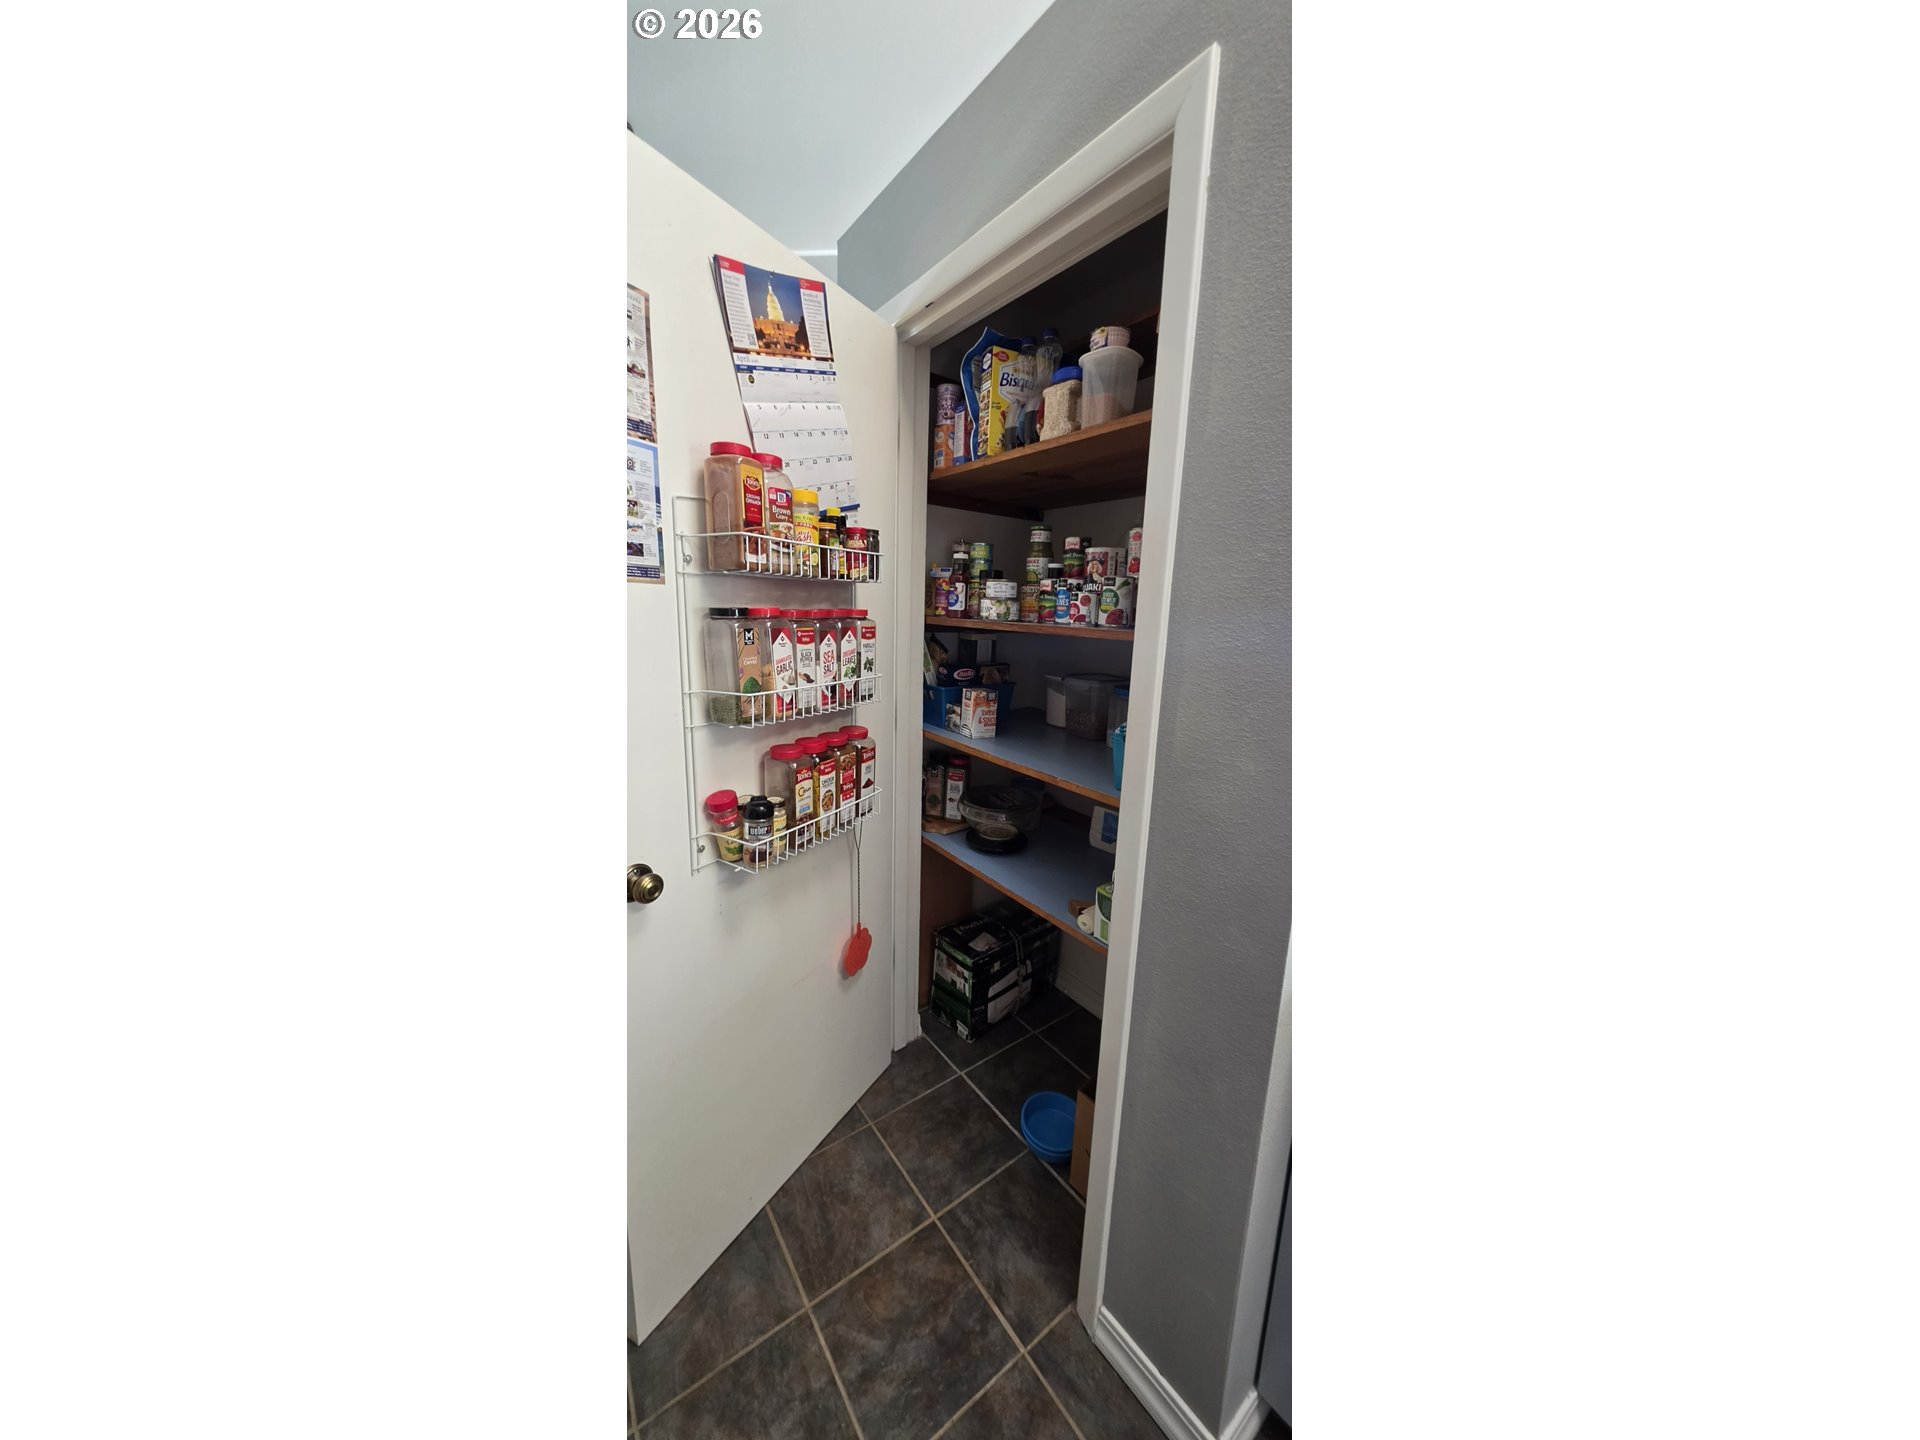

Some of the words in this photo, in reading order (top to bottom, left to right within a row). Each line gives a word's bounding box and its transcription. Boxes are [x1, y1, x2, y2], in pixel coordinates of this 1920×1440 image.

[772, 505, 791, 515] Brown
[823, 650, 835, 665] SEA
[842, 655, 856, 667] LEAVES
[776, 661, 793, 675] GARLIC
[823, 662, 835, 674] SALT
[863, 751, 875, 760] Tone's
[796, 771, 812, 782] Tone's
[749, 827, 768, 836] weber
